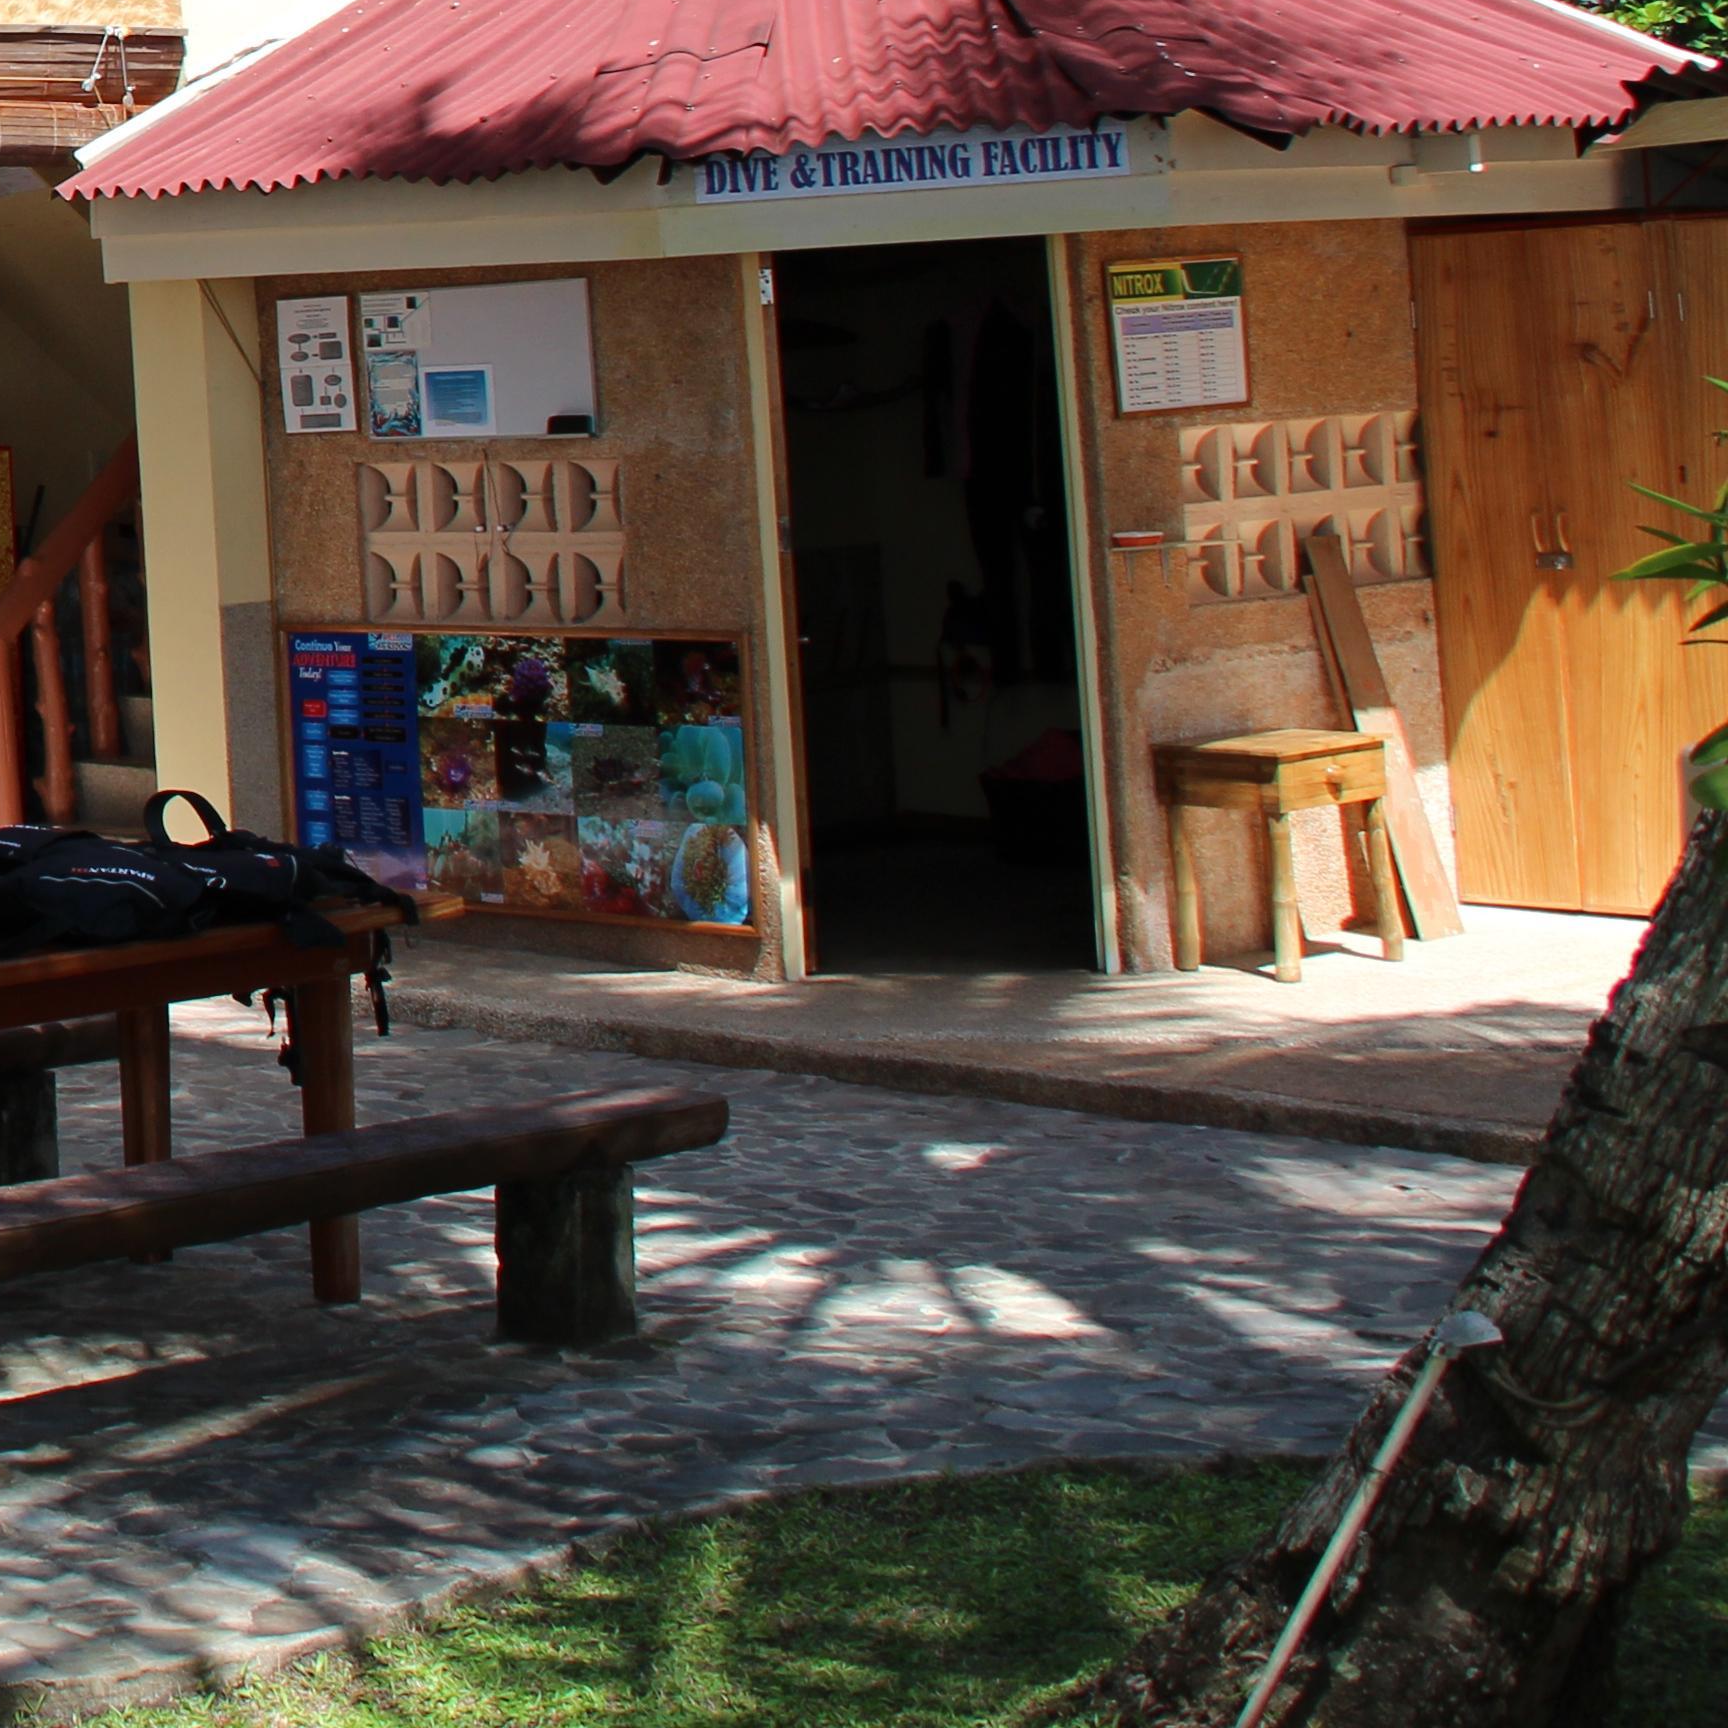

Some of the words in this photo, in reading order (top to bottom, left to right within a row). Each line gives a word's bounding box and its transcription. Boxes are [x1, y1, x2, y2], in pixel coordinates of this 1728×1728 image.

[704, 155, 779, 196] DIVE
[981, 132, 1123, 177] FACILITY
[1113, 273, 1164, 296] NITROX
[294, 639, 333, 652] Continue
[334, 640, 352, 652] Your
[293, 653, 357, 668] ADVENTURE
[299, 667, 322, 681] Today!
